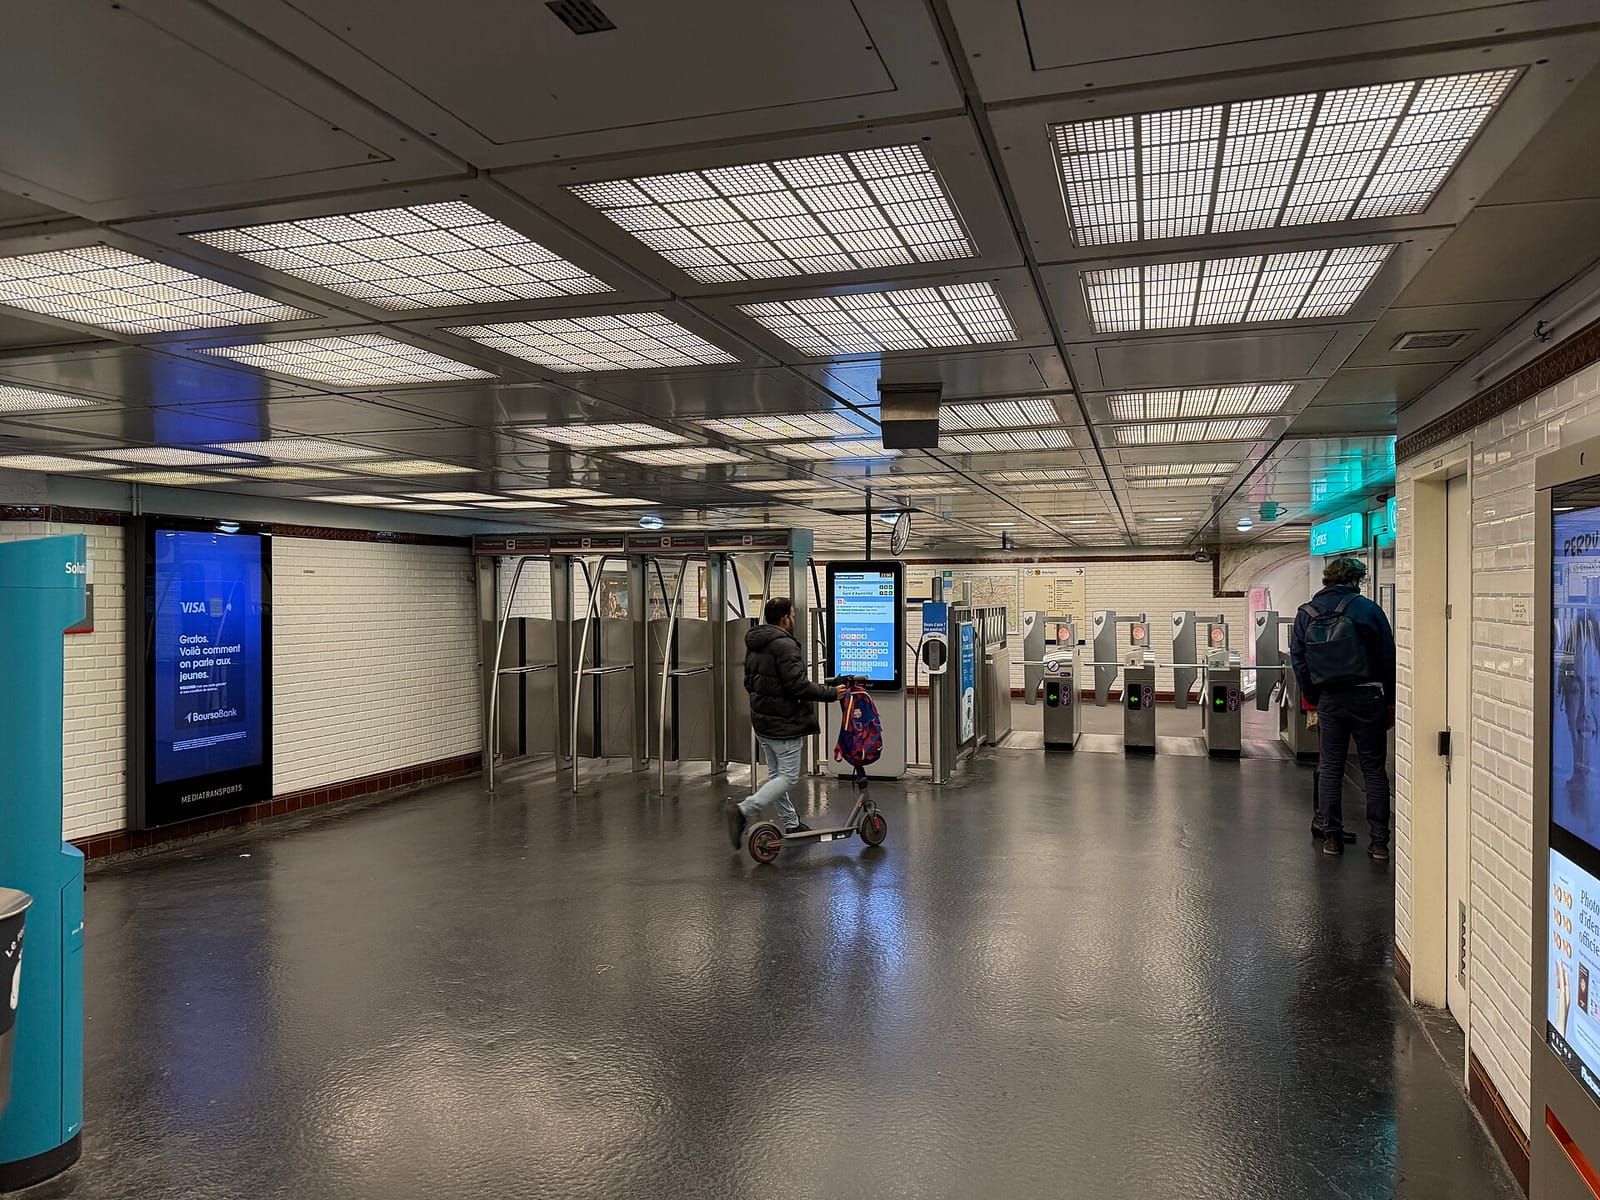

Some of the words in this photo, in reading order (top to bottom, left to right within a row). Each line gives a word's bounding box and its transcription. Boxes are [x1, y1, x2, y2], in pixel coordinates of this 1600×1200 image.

[179, 601, 206, 614] VISA
[179, 634, 209, 645] Gratos.
[180, 645, 201, 656] Voilà
[202, 643, 241, 655] comment
[180, 660, 192, 669] on
[192, 657, 215, 670] parle
[215, 657, 232, 666] aux
[179, 671, 209, 683] jeunes.
[192, 707, 238, 722] BoursoBank
[181, 783, 244, 804] MEDIATRANSPORTS
[1580, 889, 1600, 916] Photo
